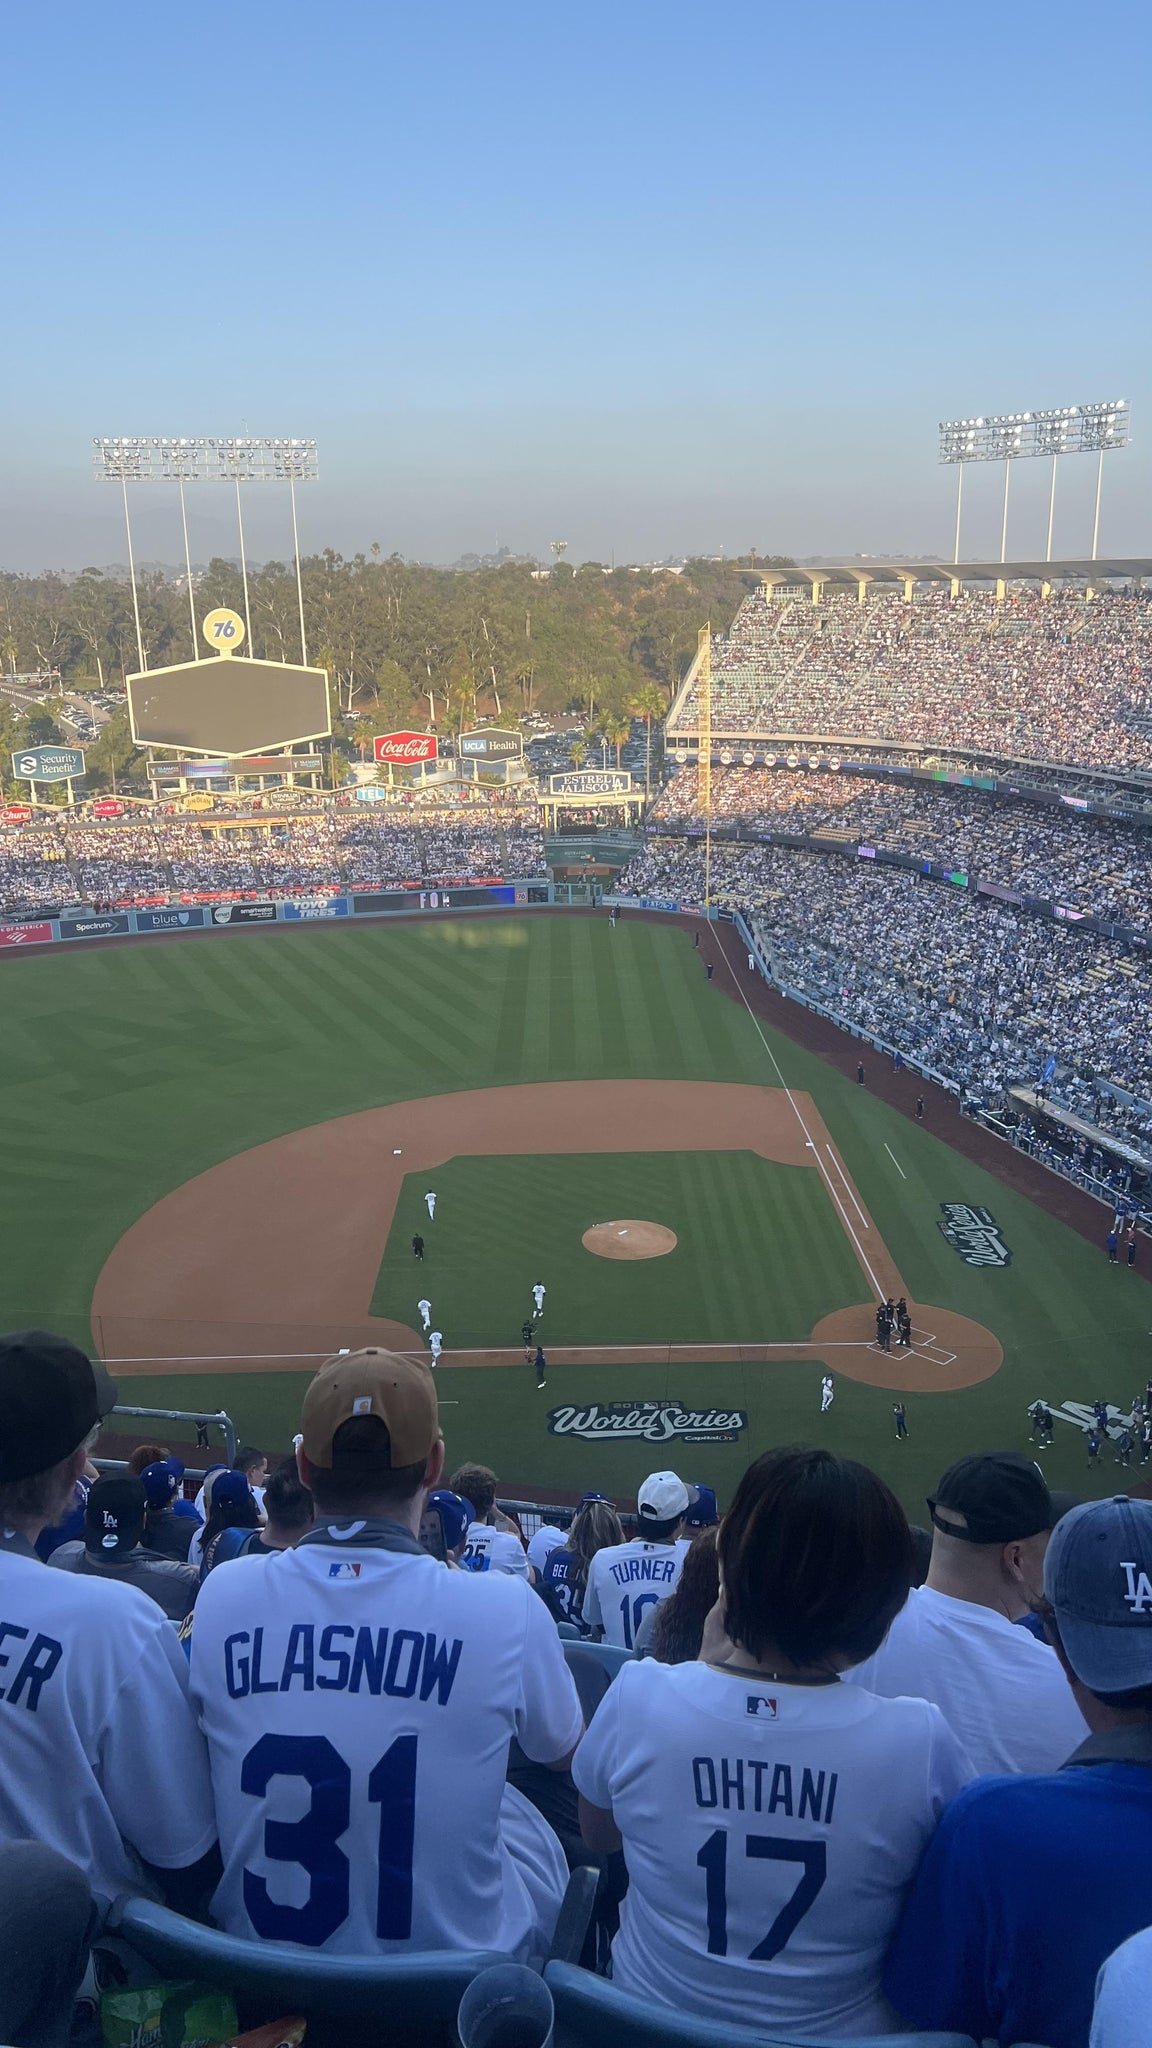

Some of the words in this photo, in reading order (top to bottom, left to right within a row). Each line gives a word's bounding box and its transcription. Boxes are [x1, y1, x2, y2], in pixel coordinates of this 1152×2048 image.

[213, 620, 236, 638] 76
[380, 739, 431, 757] Coca-Cola
[489, 741, 518, 750] Health
[40, 753, 78, 764] Security
[42, 763, 76, 774] Benefit
[361, 789, 382, 799] TEL
[558, 783, 609, 793] JALISCO
[0, 810, 30, 821] Churu
[293, 900, 328, 909] TOYO
[299, 907, 337, 917] TIRES
[152, 913, 178, 925] blue
[75, 922, 112, 932] Spectrum
[553, 1406, 660, 1433] World
[645, 1407, 743, 1441] Series
[103, 1510, 118, 1528] LA
[609, 1559, 676, 1586] TURNER
[1119, 1561, 1152, 1614] LA
[224, 1624, 463, 1706] GLASNOW
[692, 1756, 838, 1824] OHTANI
[240, 1733, 418, 1947] 31
[696, 1829, 827, 1961] 17
